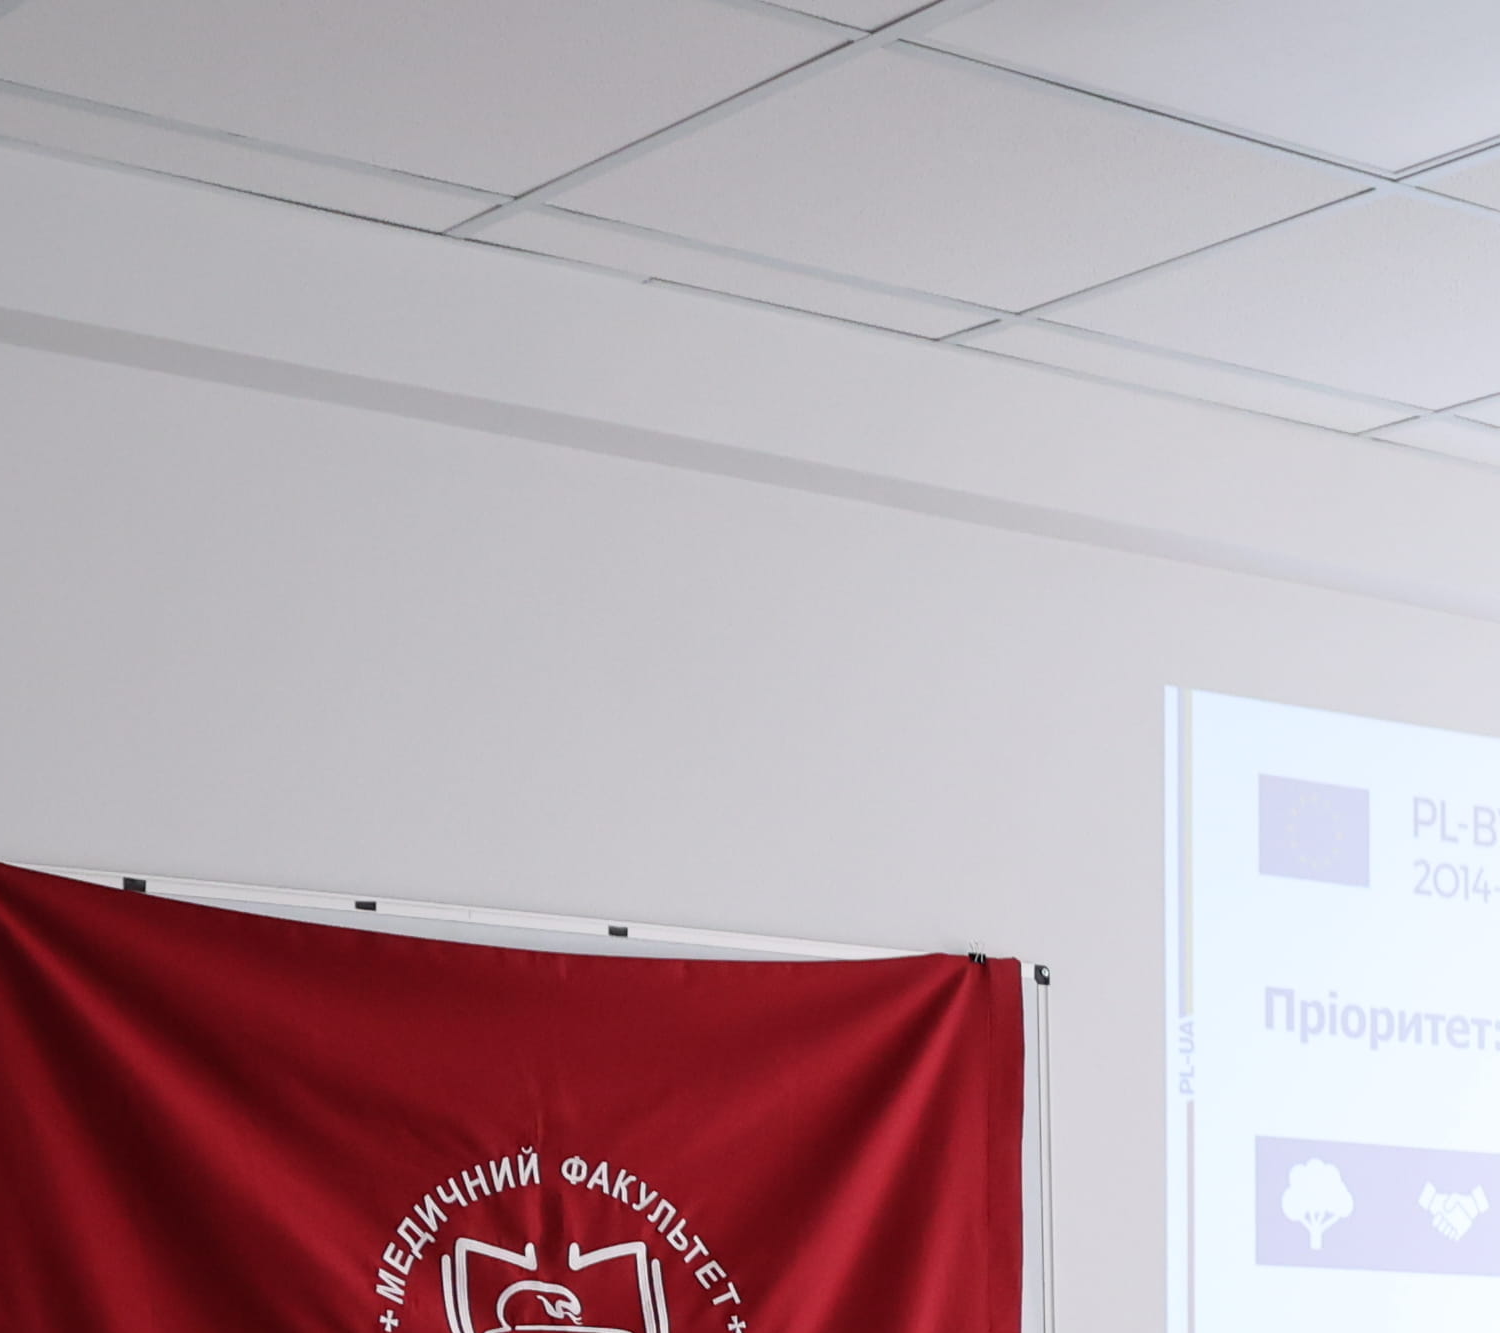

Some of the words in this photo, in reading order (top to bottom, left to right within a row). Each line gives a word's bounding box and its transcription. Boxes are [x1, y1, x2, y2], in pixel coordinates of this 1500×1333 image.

[1180, 1020, 1195, 1095] PL-UA
[376, 1146, 541, 1304] МЕДИЧНИЙ
[561, 1156, 740, 1306] ФАКУЛЬТЕТ
